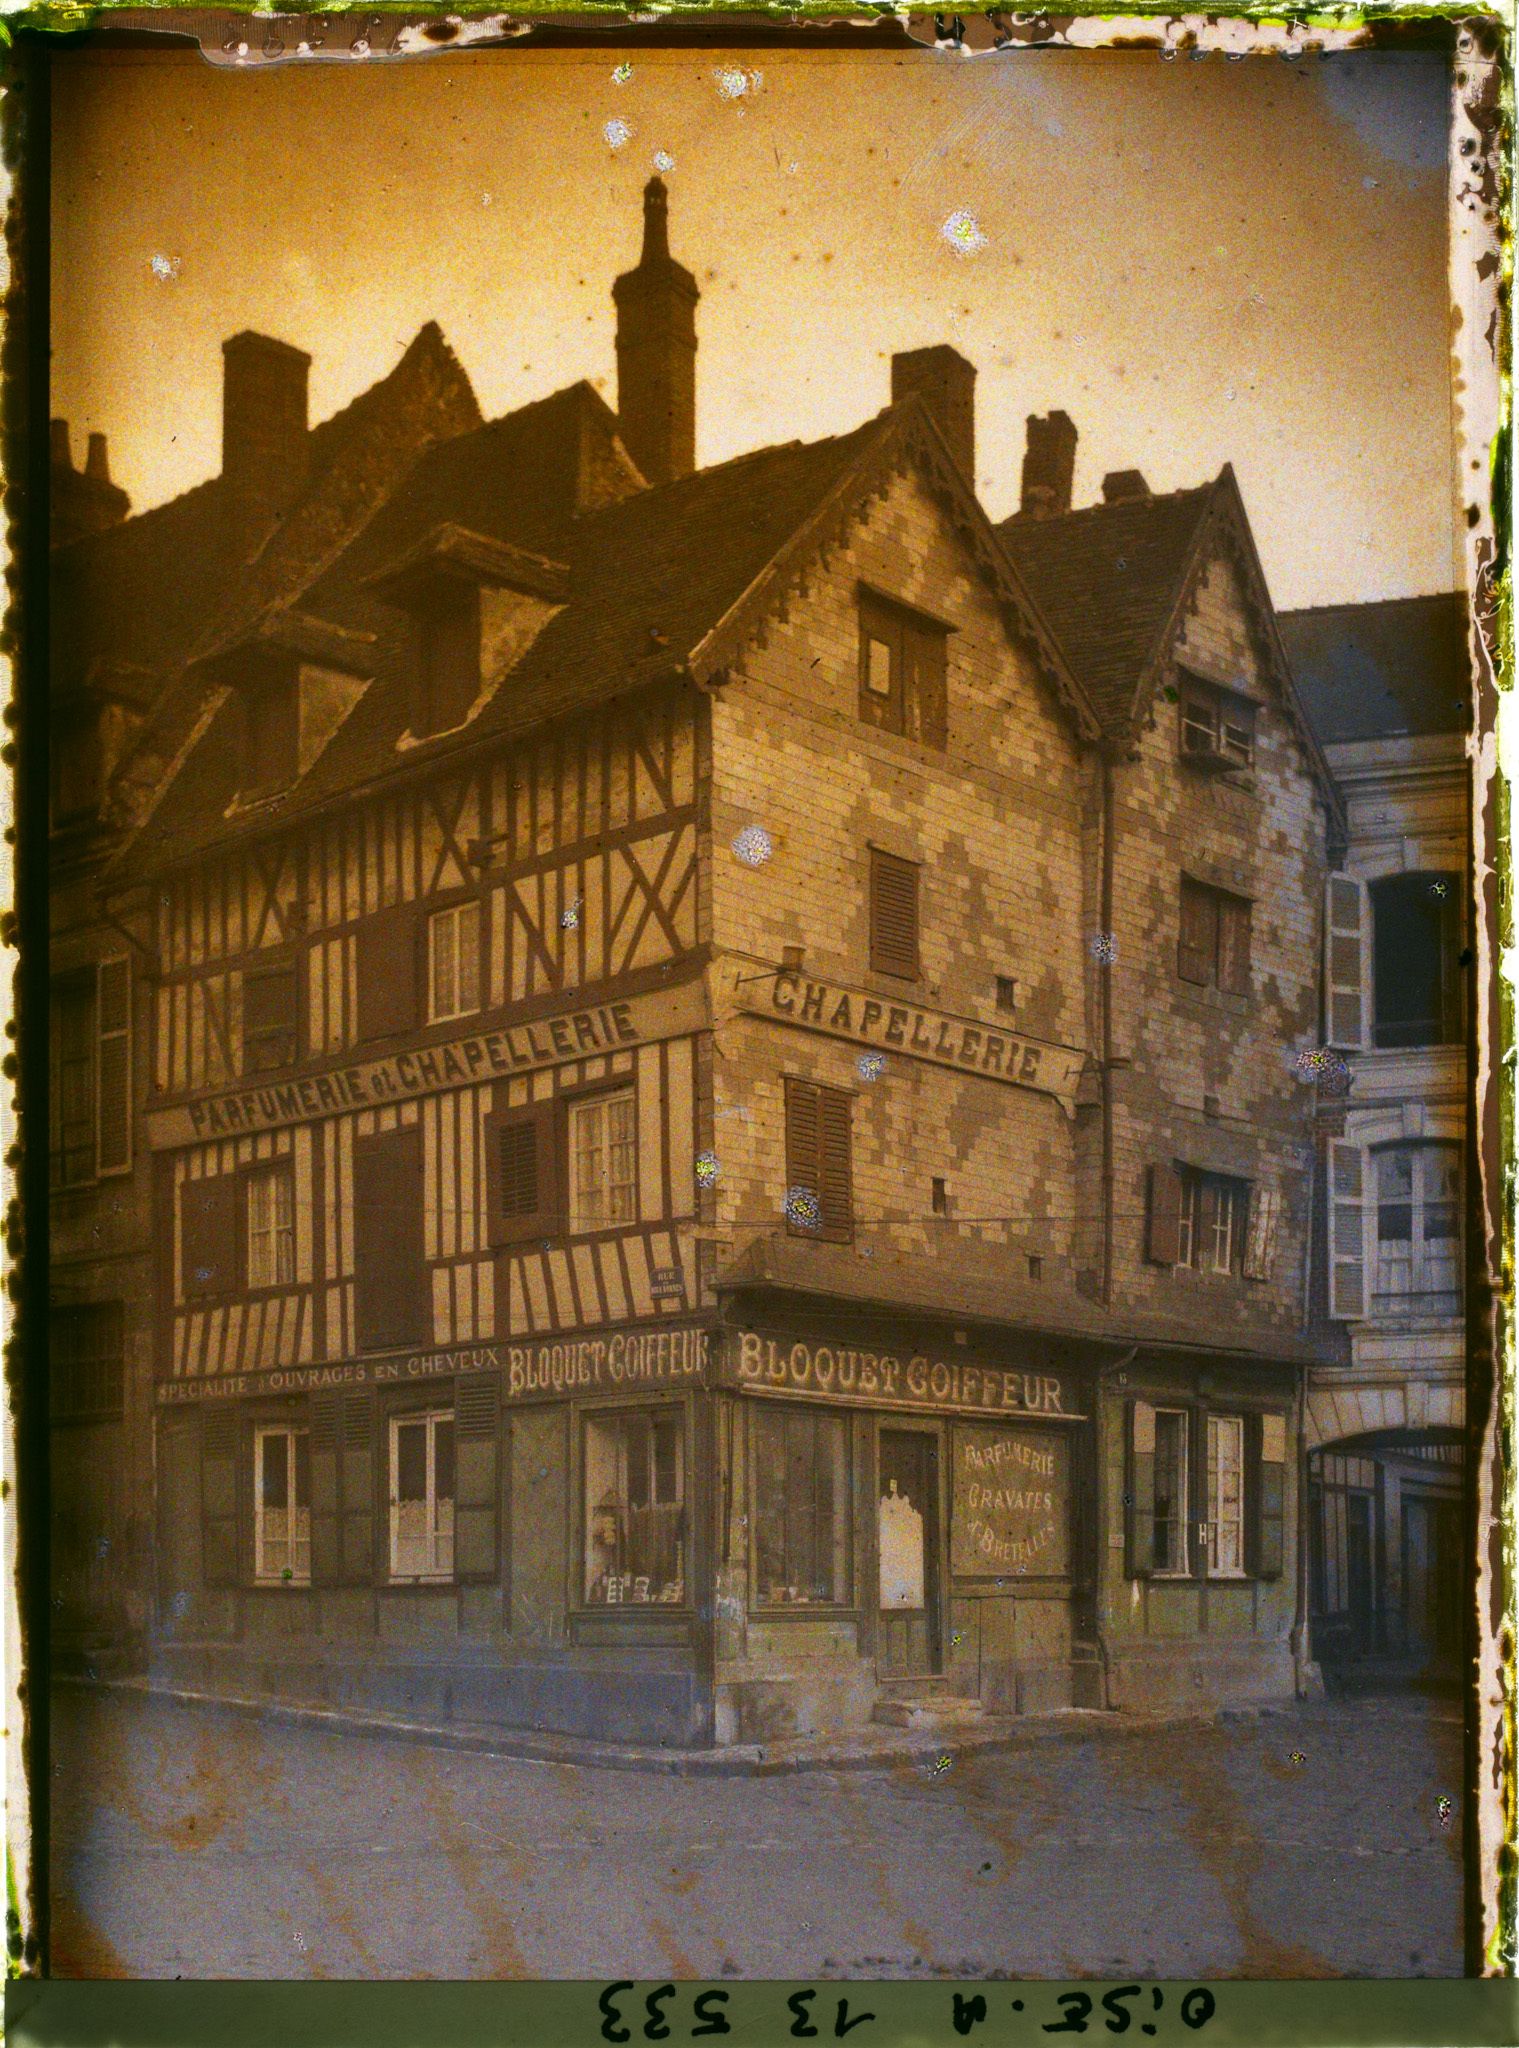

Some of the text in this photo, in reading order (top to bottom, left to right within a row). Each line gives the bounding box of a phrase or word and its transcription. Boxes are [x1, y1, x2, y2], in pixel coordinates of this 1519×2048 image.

[772, 975, 1042, 1081] CHAPELLERIE
[188, 1070, 372, 1135] PARFUMERIE
[398, 1003, 640, 1090] CHAPELLERIE
[374, 1365, 399, 1379] EN
[407, 1348, 499, 1375] CHEVEUX
[508, 1328, 709, 1396] BLOQUET COIFFEUR
[738, 1331, 1064, 1414] BLOQUET COIFFEUR
[964, 1441, 1055, 1475] PARFUMERIE
[968, 1483, 1052, 1511] CRAVATES
[599, 1981, 731, 2043] 533
